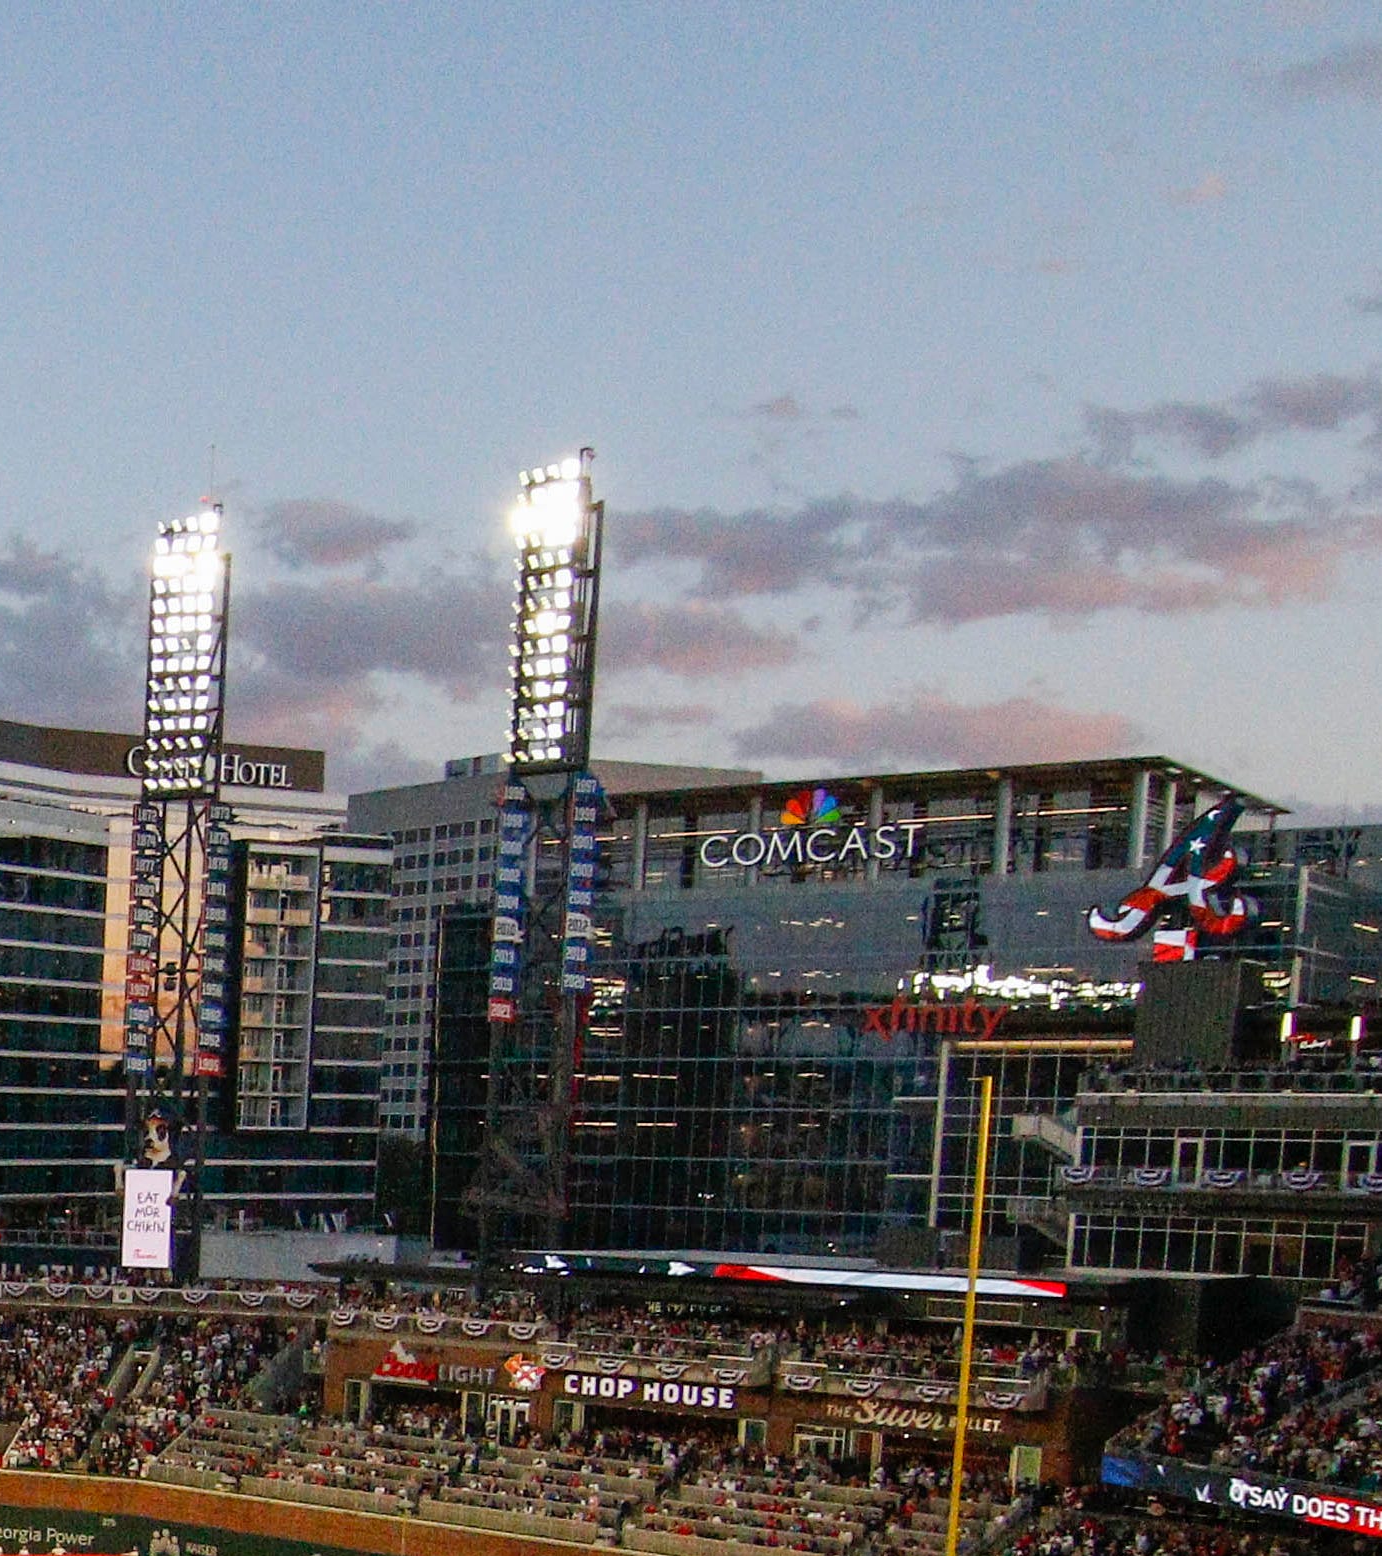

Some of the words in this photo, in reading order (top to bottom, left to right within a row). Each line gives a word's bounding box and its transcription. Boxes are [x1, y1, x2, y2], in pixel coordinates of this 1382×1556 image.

[220, 753, 292, 787] HOTEL
[699, 824, 924, 868] COMCAST
[137, 1192, 159, 1204] EAT
[135, 1206, 160, 1218] MOR
[127, 1220, 165, 1233] CHIKIN
[438, 1364, 495, 1387] LIGHT
[564, 1373, 634, 1401] CHOP
[643, 1380, 735, 1410] HOUSE
[826, 1404, 852, 1418] THE
[1292, 1494, 1350, 1523] DOES
[46, 1527, 96, 1546] Power
